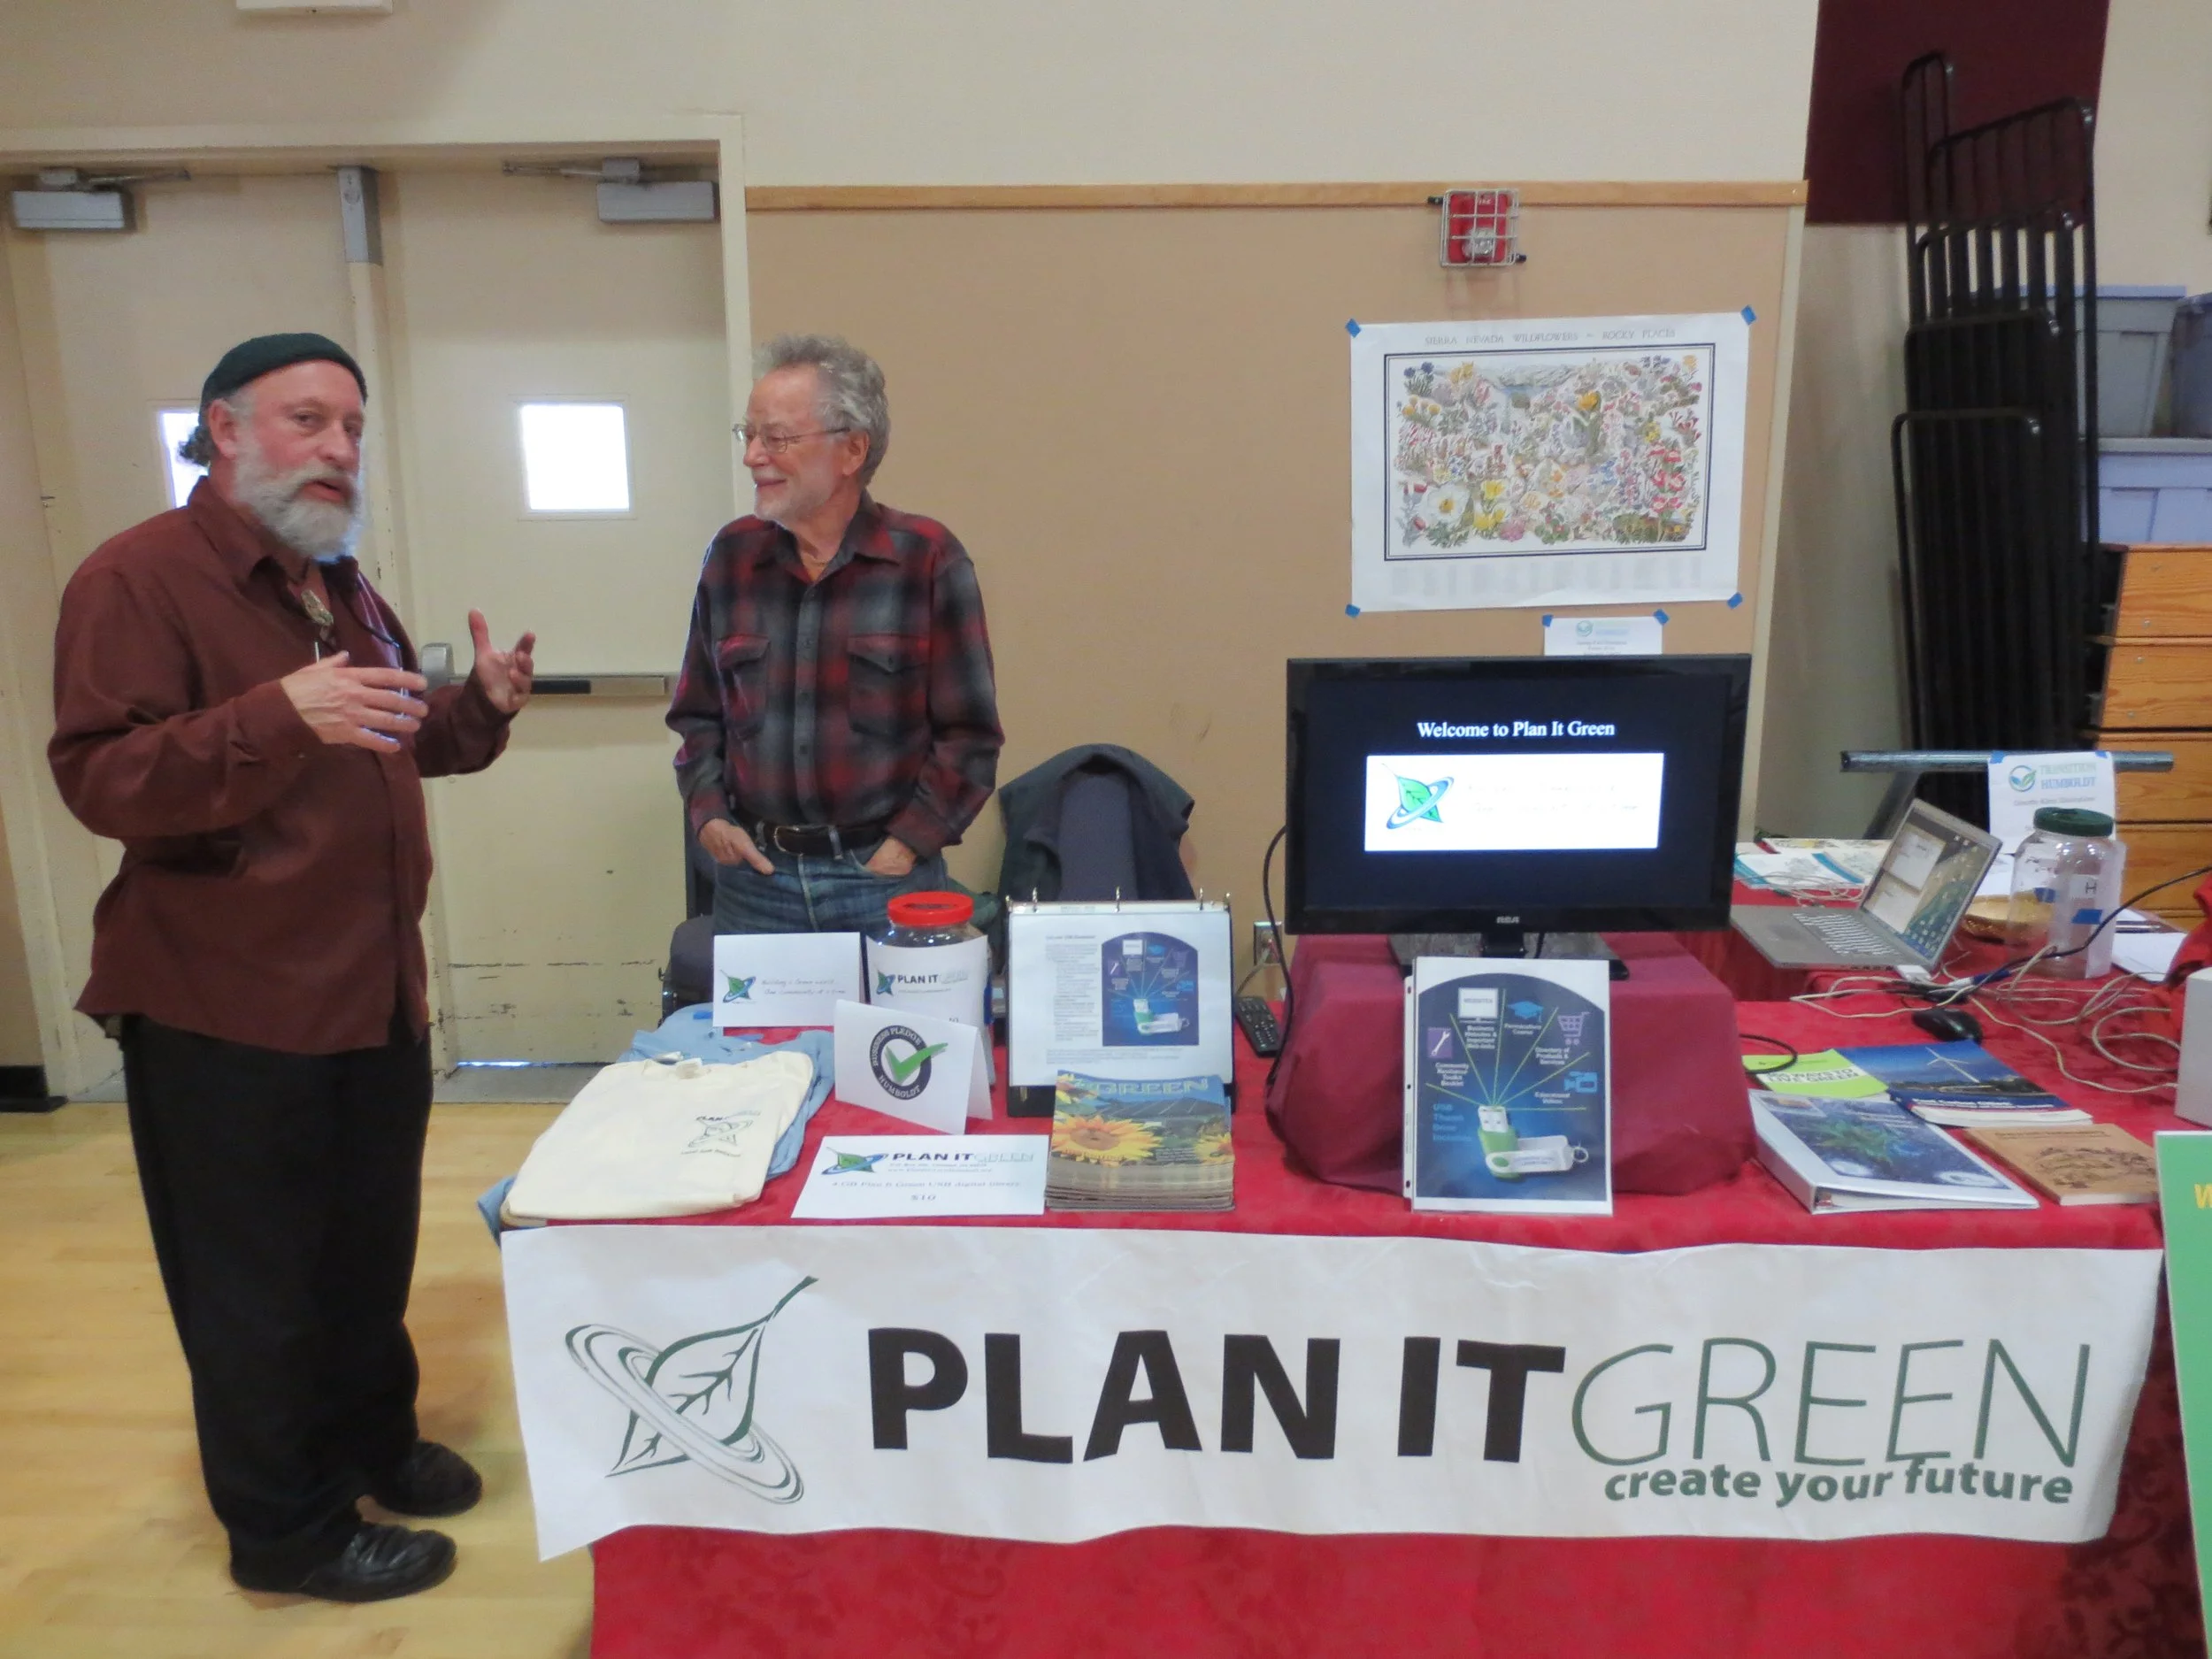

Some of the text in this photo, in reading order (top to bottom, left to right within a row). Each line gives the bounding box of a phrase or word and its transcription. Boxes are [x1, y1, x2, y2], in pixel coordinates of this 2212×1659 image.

[1425, 328, 1676, 346] SIERRA NEVADA WILDFLOWERS ROCKY PLACES
[1417, 720, 1615, 737] Welcome to Plan It Green
[2040, 776, 2096, 790] HUMBOLDT
[897, 974, 926, 984] PLAN
[928, 973, 939, 983] IT
[890, 1026, 922, 1046] PLEDGE
[878, 1074, 921, 1098] HUMBOLDT
[1096, 1078, 1210, 1096] GREEN
[892, 1152, 949, 1161] PLAN
[954, 1152, 974, 1161] IT
[868, 1327, 2091, 1468] PLAN IT GREEN
[1604, 1457, 2073, 1508] create your future
